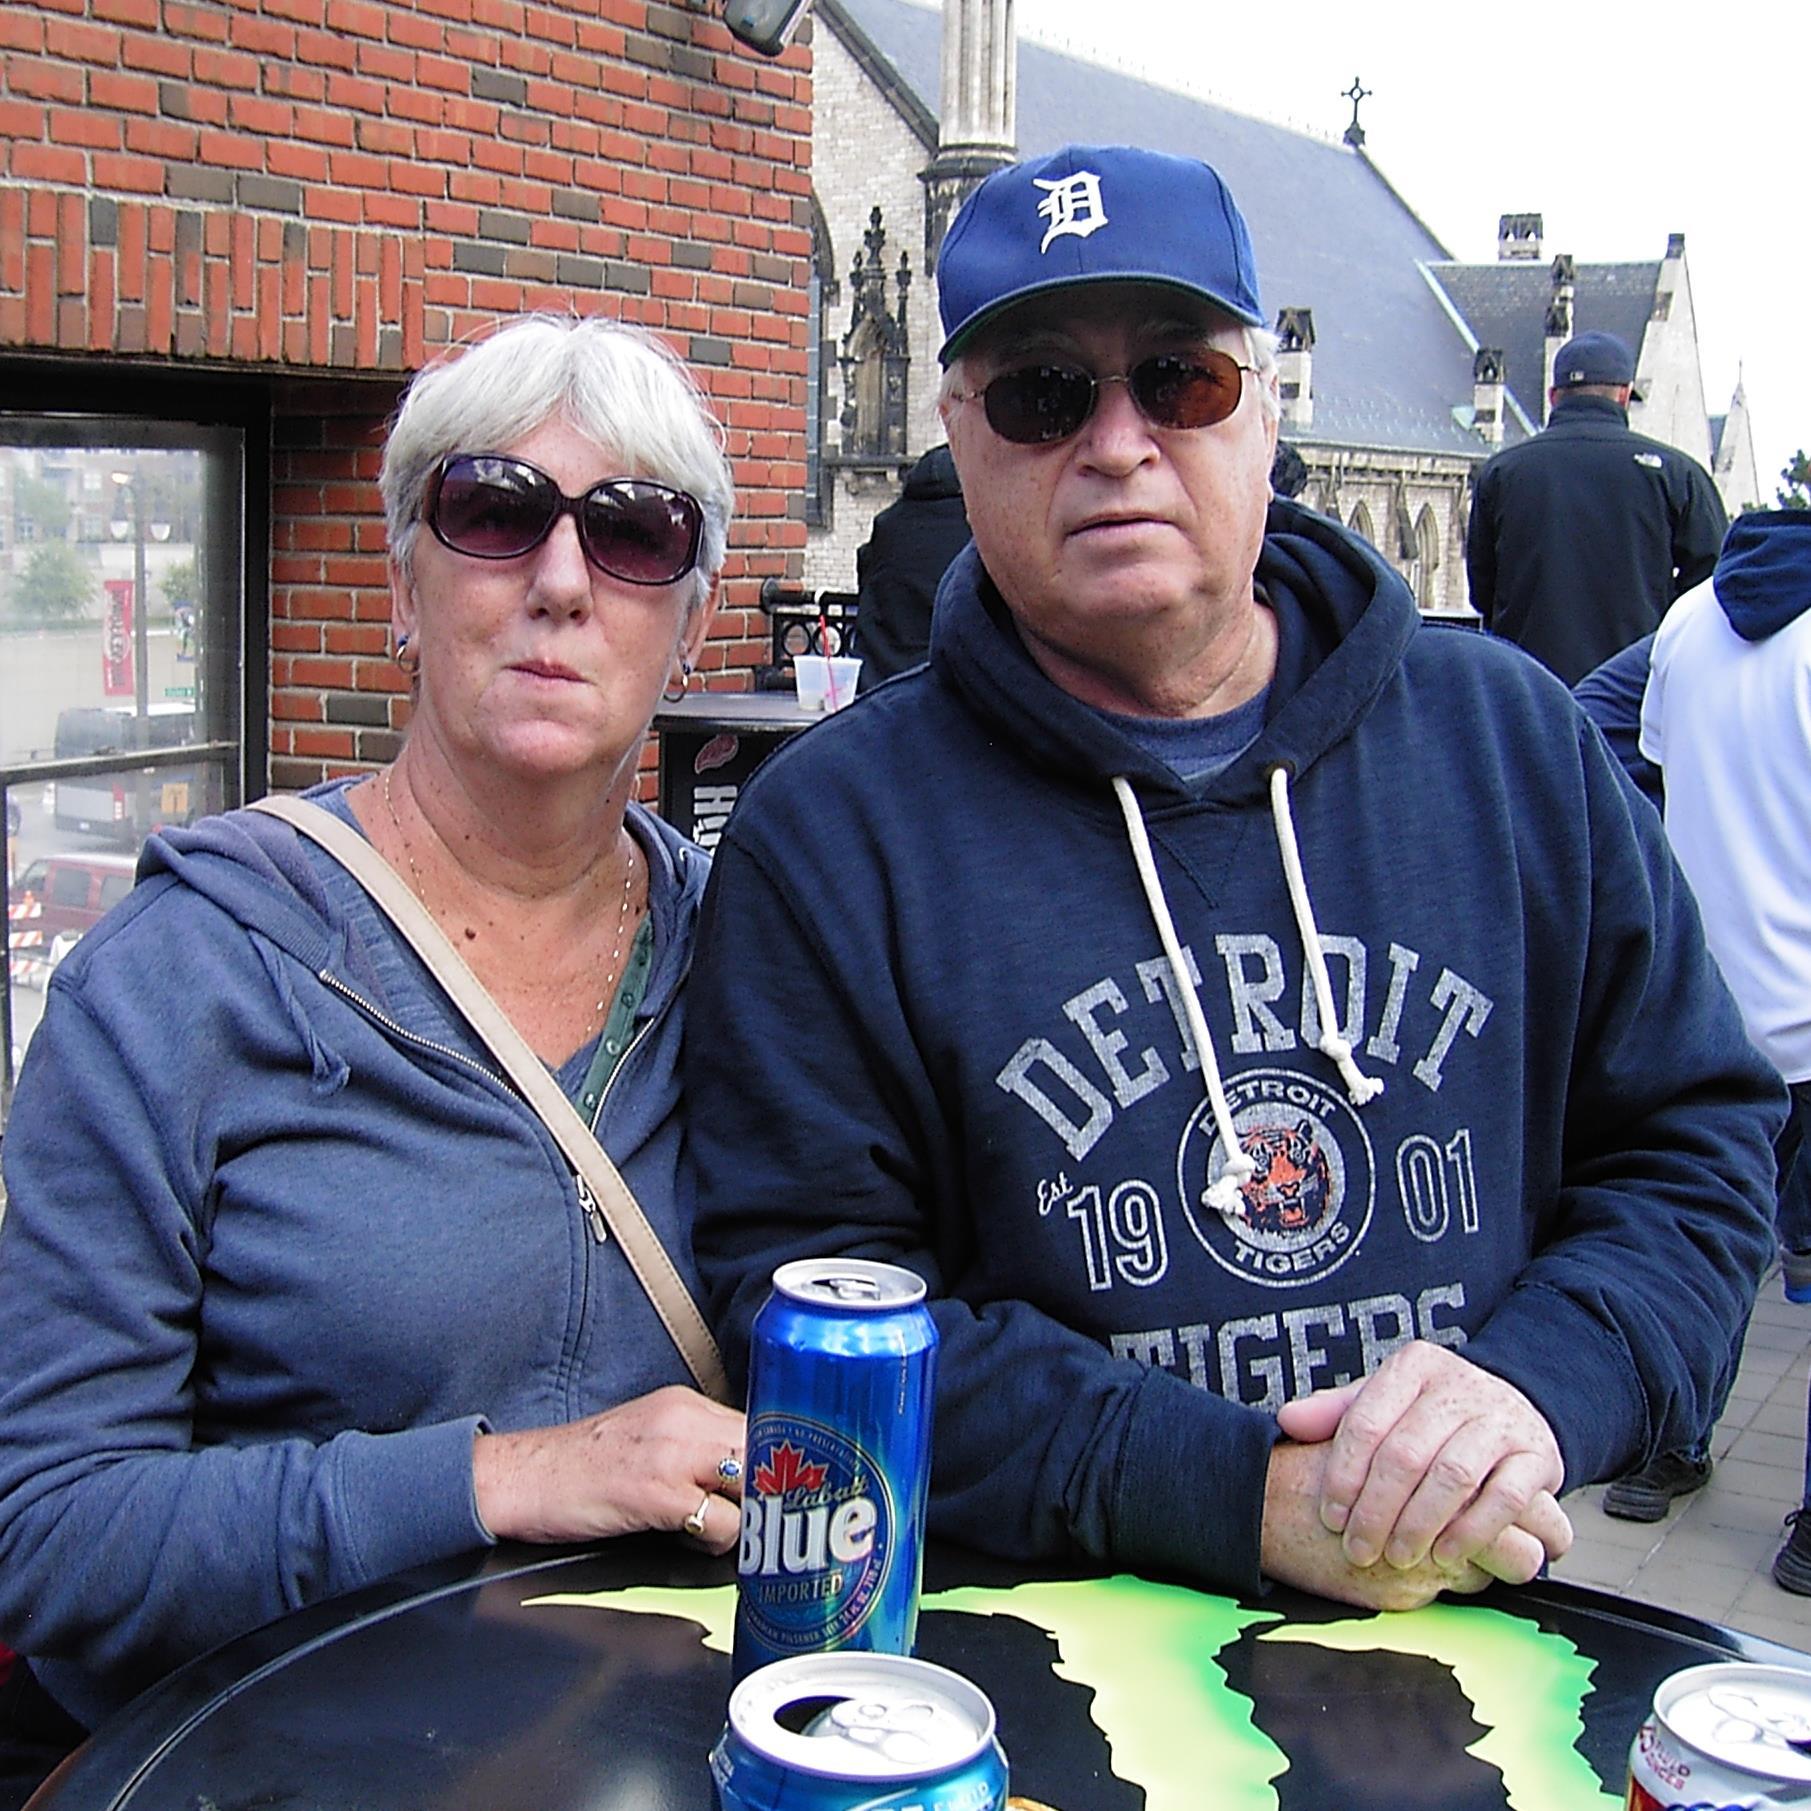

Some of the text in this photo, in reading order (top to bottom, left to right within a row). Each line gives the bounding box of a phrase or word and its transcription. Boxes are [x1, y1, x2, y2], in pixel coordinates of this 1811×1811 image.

[1033, 171, 1109, 254] D
[996, 933, 1494, 1162] DETROIT
[1198, 1079, 1337, 1137] DETROIT
[1037, 1171, 1074, 1216] Est
[1066, 1128, 1479, 1291] 19 01
[1235, 1221, 1351, 1274] TIGERS
[1110, 1282, 1468, 1416] TIGERS
[738, 1494, 877, 1575] Blue
[758, 1574, 843, 1604] IMPORTED
